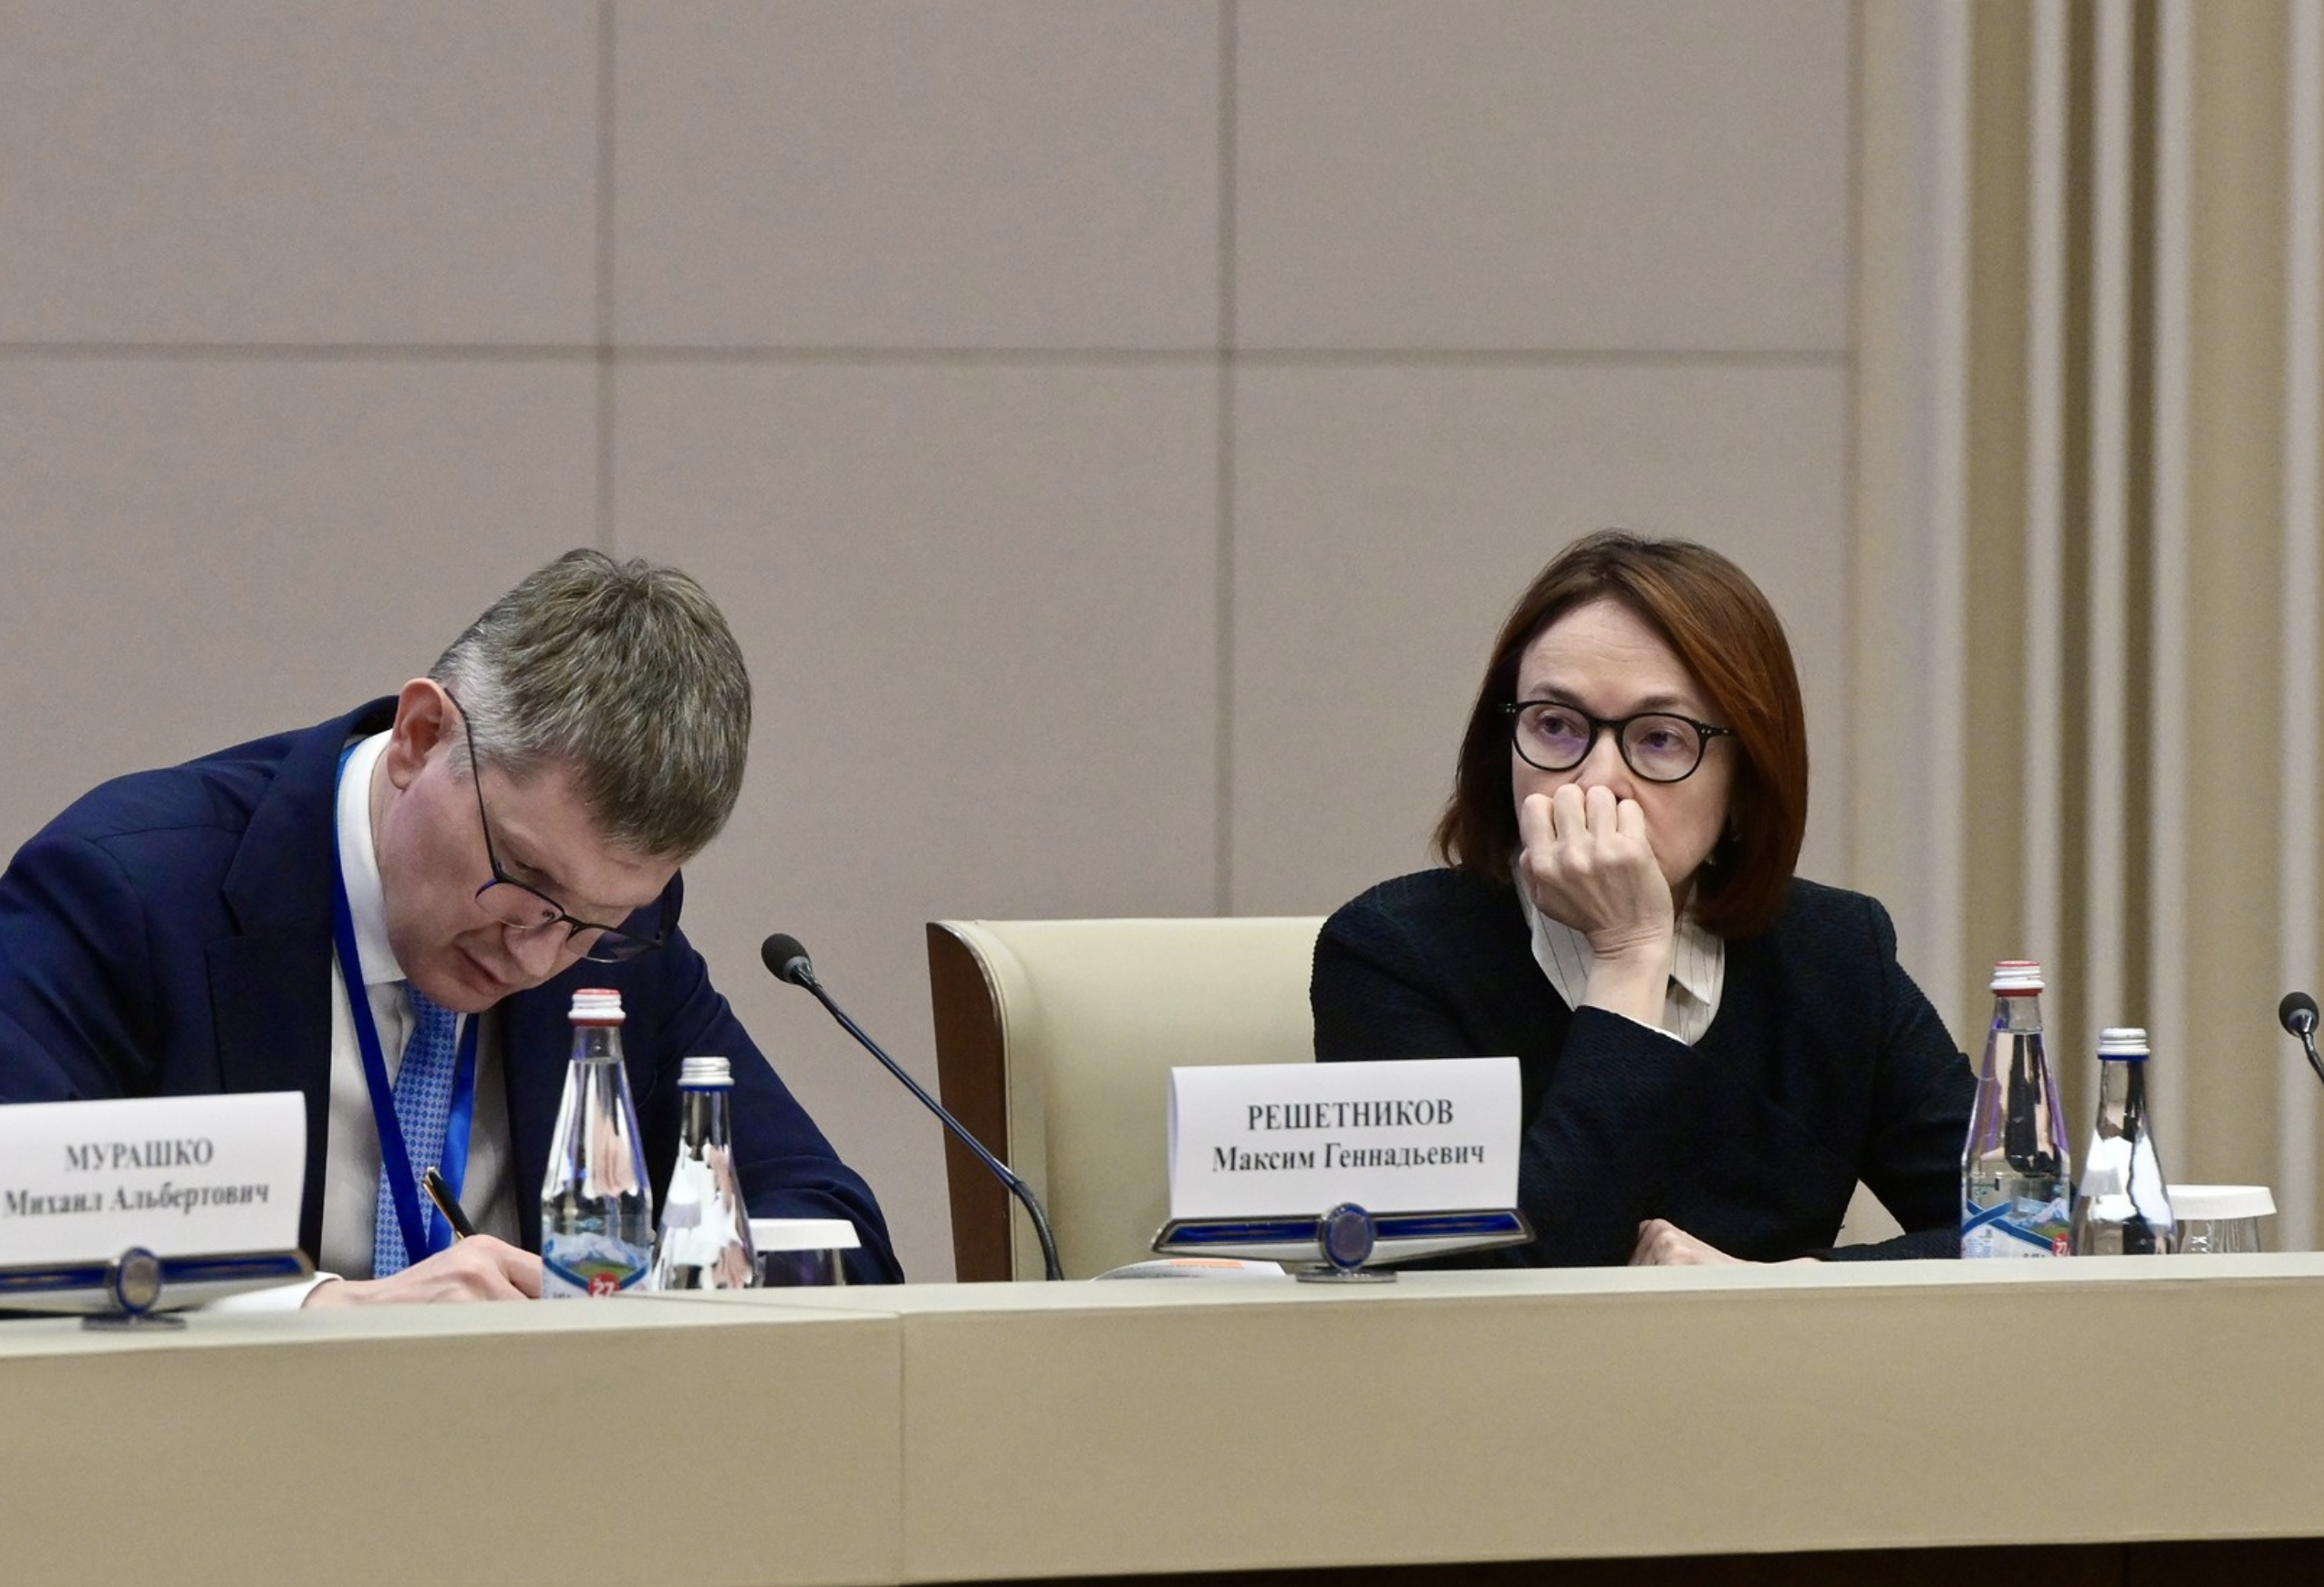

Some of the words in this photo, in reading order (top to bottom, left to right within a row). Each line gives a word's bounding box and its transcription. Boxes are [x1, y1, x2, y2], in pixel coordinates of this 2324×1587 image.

[1247, 1098, 1454, 1131] РЕШЕТНИКОВ
[65, 1137, 214, 1171] МУРАШКО
[1212, 1145, 1315, 1172] Максим
[1323, 1141, 1485, 1169] Геннадьевич
[4, 1188, 103, 1217] Михаил
[109, 1180, 270, 1215] Альбертович
